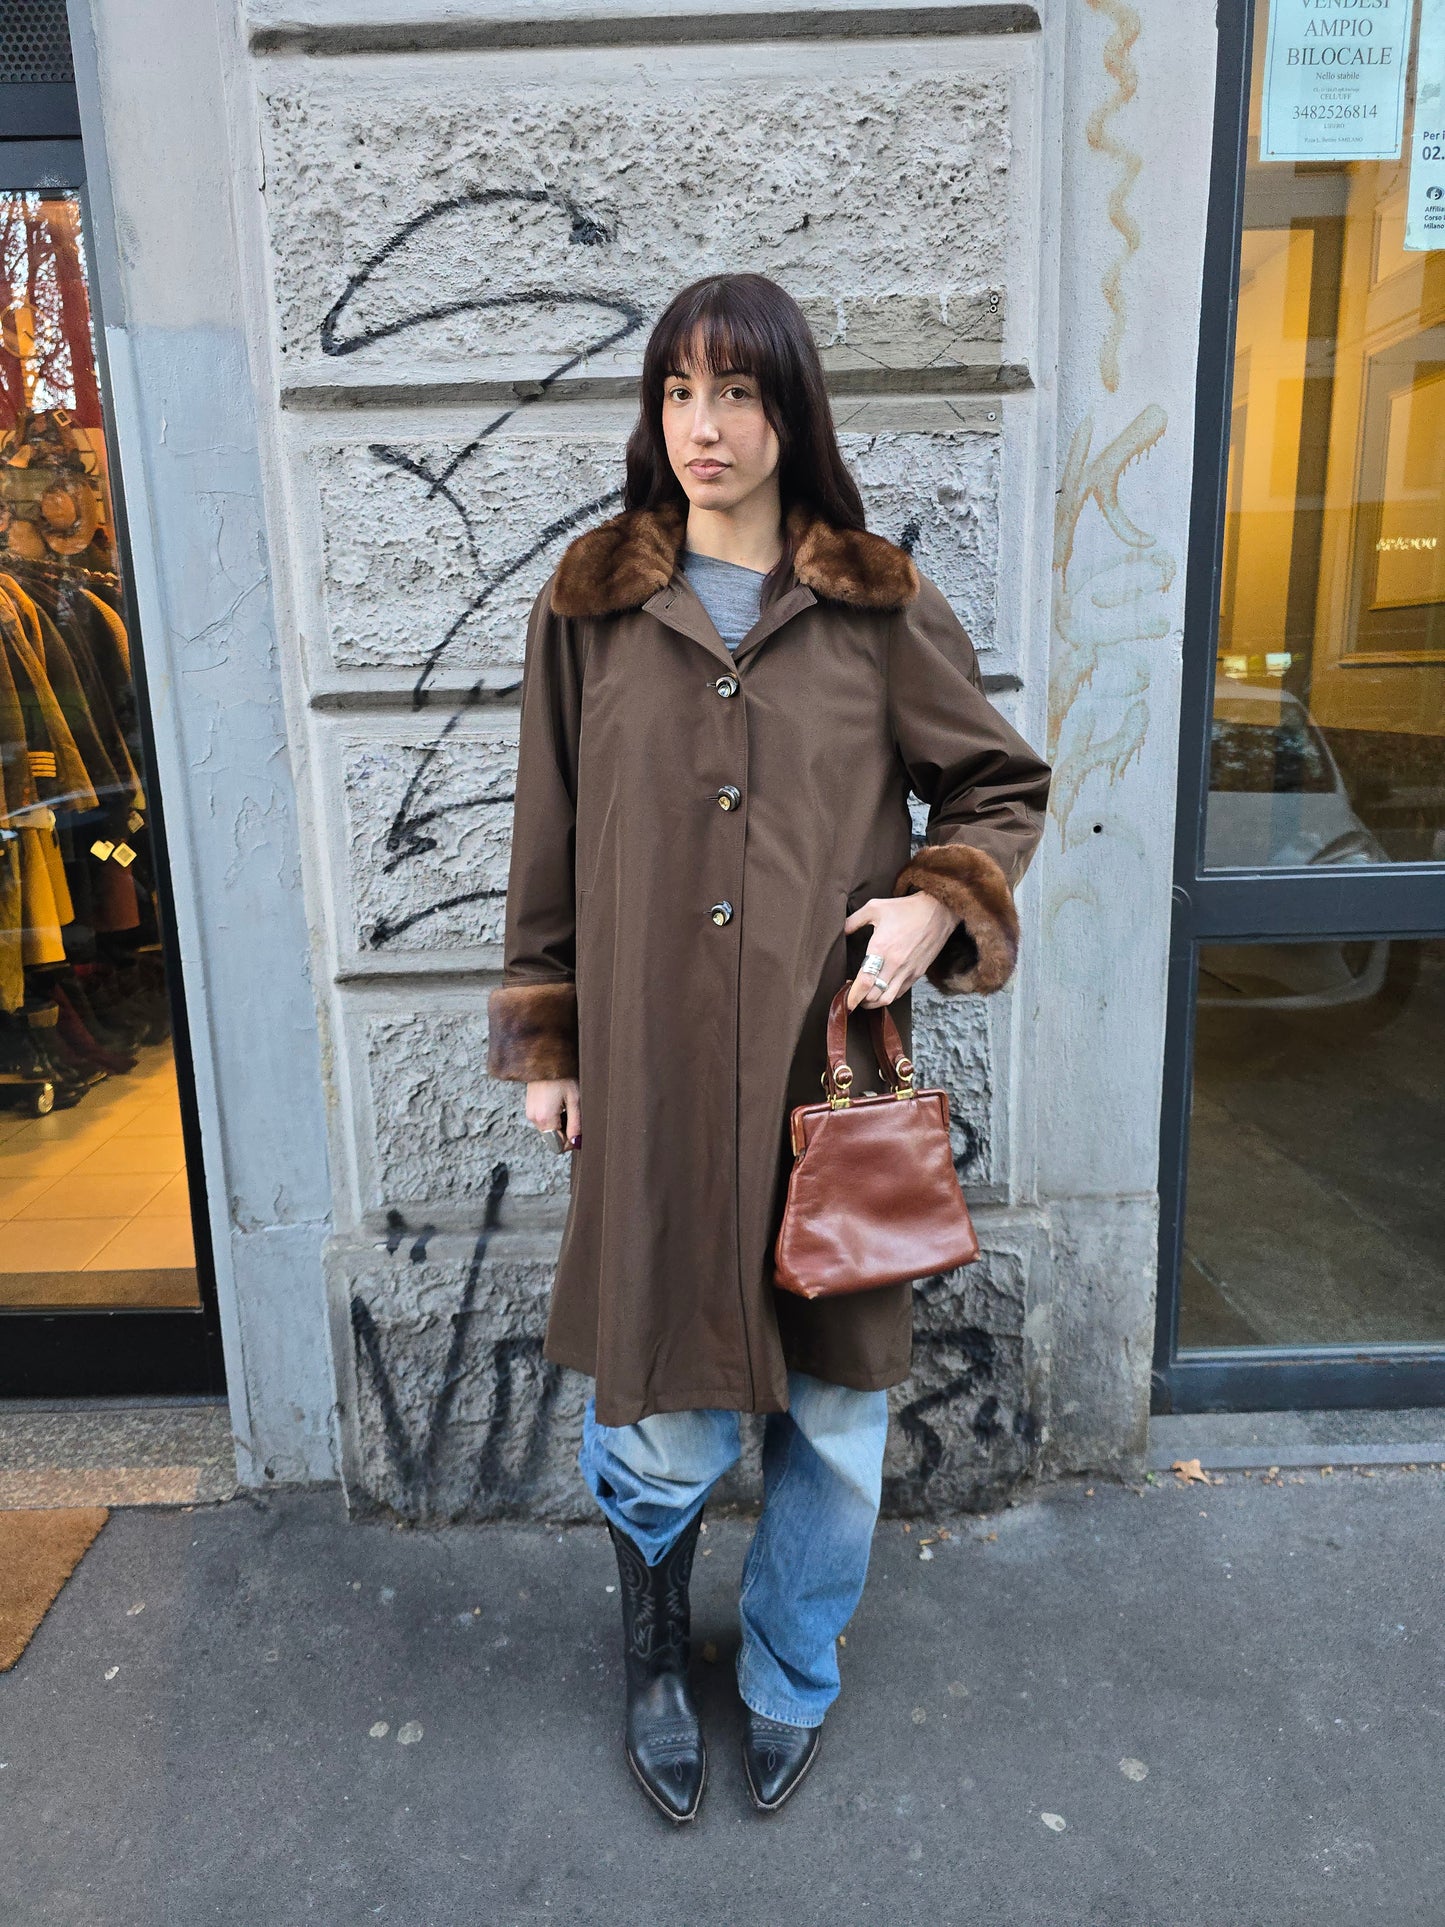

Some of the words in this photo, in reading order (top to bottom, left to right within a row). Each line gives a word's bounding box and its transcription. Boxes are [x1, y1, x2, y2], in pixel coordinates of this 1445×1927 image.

[1303, 18, 1374, 37] AMPIO
[1286, 47, 1393, 66] BILOCALE
[1315, 72, 1336, 80] Nello
[1337, 72, 1360, 80] stabile
[1292, 104, 1378, 120] 3482526814
[1423, 131, 1441, 140] Per
[1424, 222, 1445, 230] Milano
